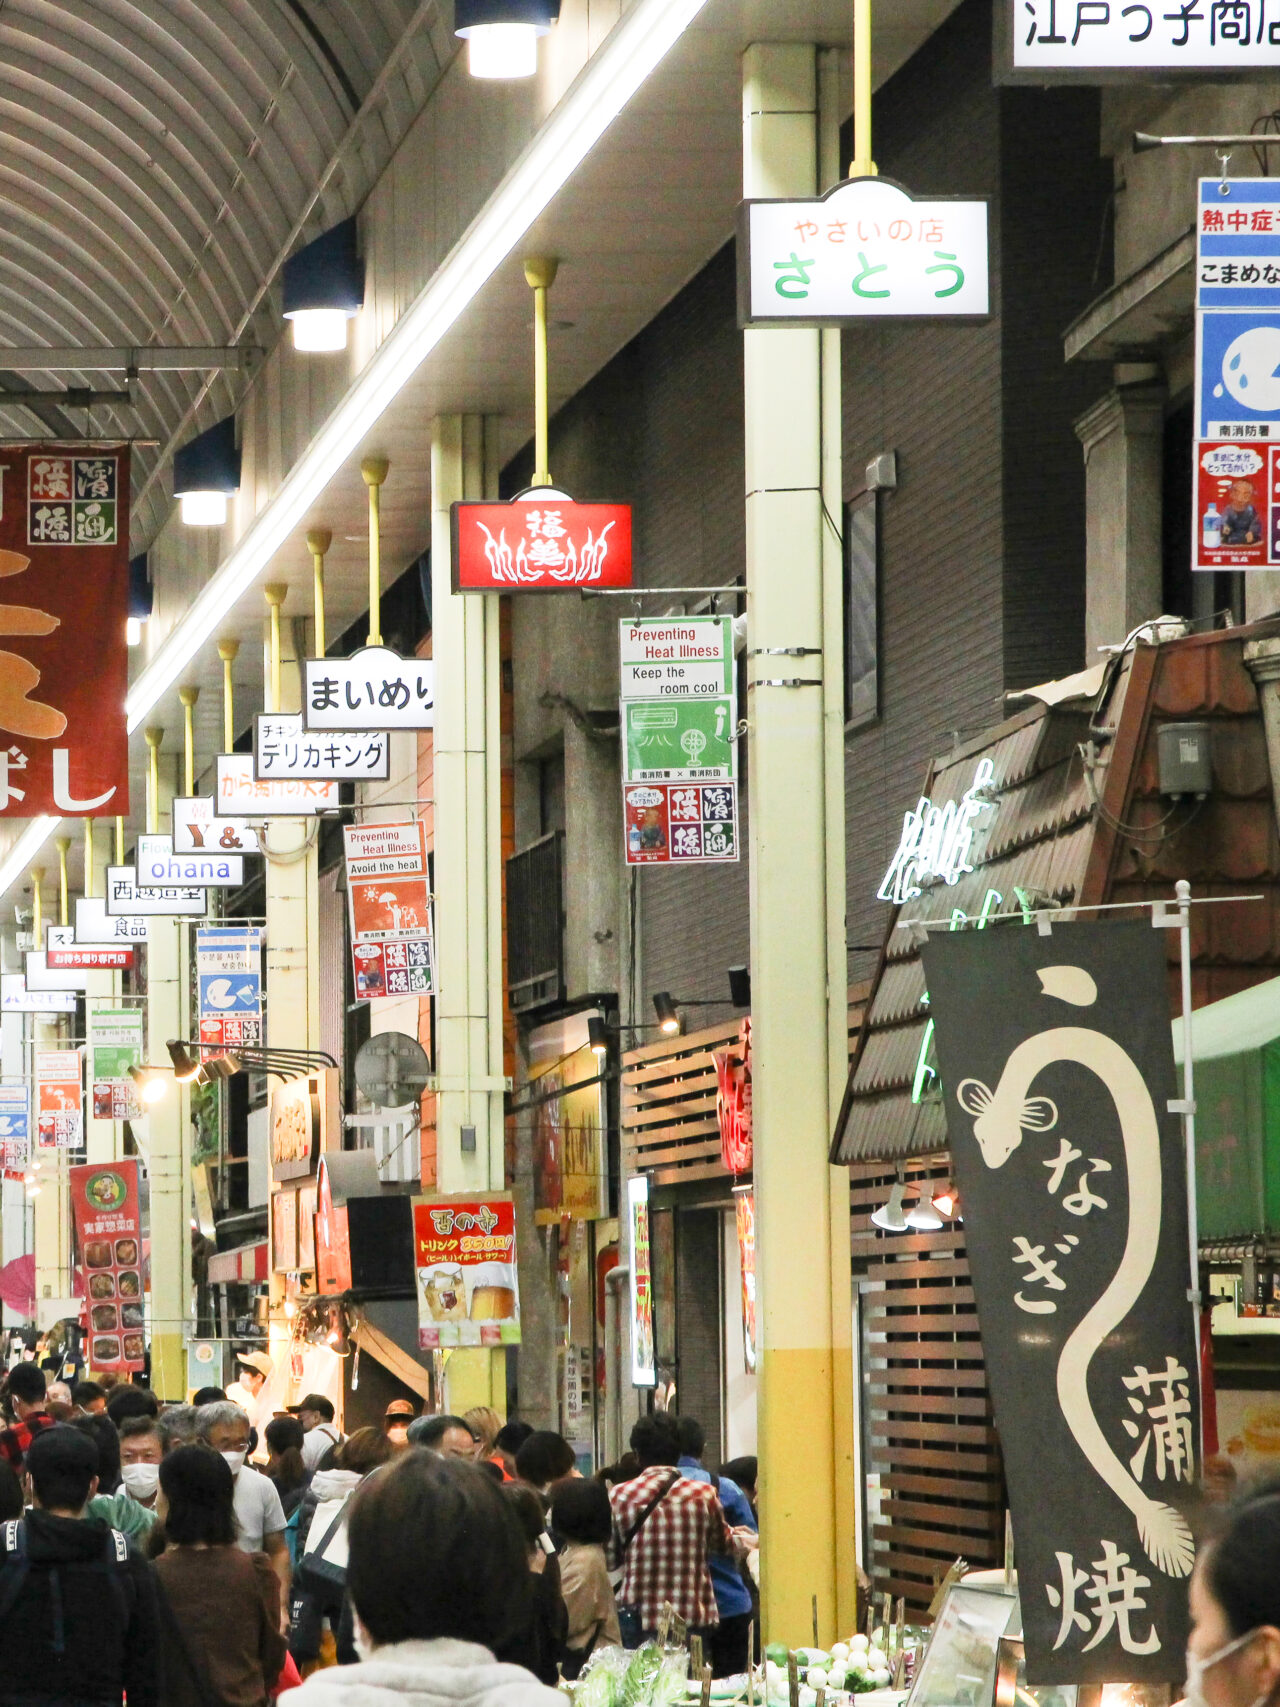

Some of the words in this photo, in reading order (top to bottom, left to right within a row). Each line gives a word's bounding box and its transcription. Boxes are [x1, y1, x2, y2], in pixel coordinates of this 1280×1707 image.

[1202, 209, 1280, 232] 熱中症
[794, 218, 945, 244] やさいの店
[773, 250, 965, 299] さとう
[1219, 424, 1270, 438] 南消防署
[526, 509, 566, 566] 福美
[630, 628, 696, 642] Preventing
[645, 645, 675, 659] Heat
[680, 644, 719, 657] Illness
[632, 667, 662, 680] Keep
[666, 666, 685, 677] the
[660, 684, 689, 694] room
[694, 681, 719, 693] cool
[263, 742, 383, 769] デリカキング
[186, 824, 209, 848] Y
[219, 826, 244, 849] &
[350, 831, 400, 843] Preventing
[363, 845, 384, 855] Heat
[387, 843, 418, 853] Illness
[151, 859, 230, 879] ohana
[351, 863, 377, 874] Avoid
[380, 861, 395, 871] the
[397, 860, 418, 870] heat
[421, 1239, 458, 1252] ドリンク
